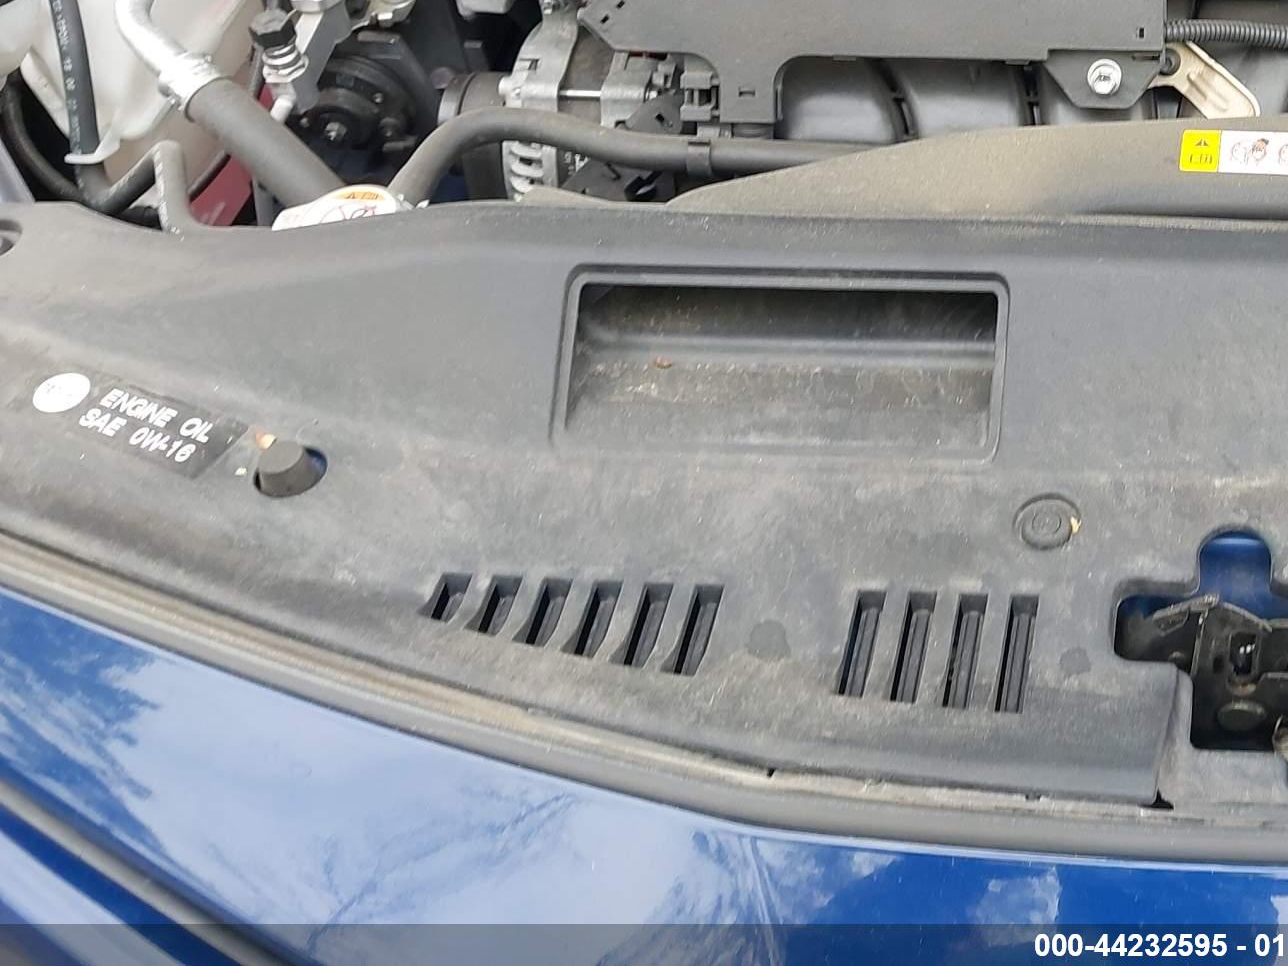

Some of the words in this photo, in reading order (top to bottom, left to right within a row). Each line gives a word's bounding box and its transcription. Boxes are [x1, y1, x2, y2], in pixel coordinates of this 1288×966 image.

[78, 408, 128, 437] SAE
[129, 427, 197, 463] 0W-16
[99, 388, 179, 428] ENGINE
[179, 417, 214, 443] OIL
